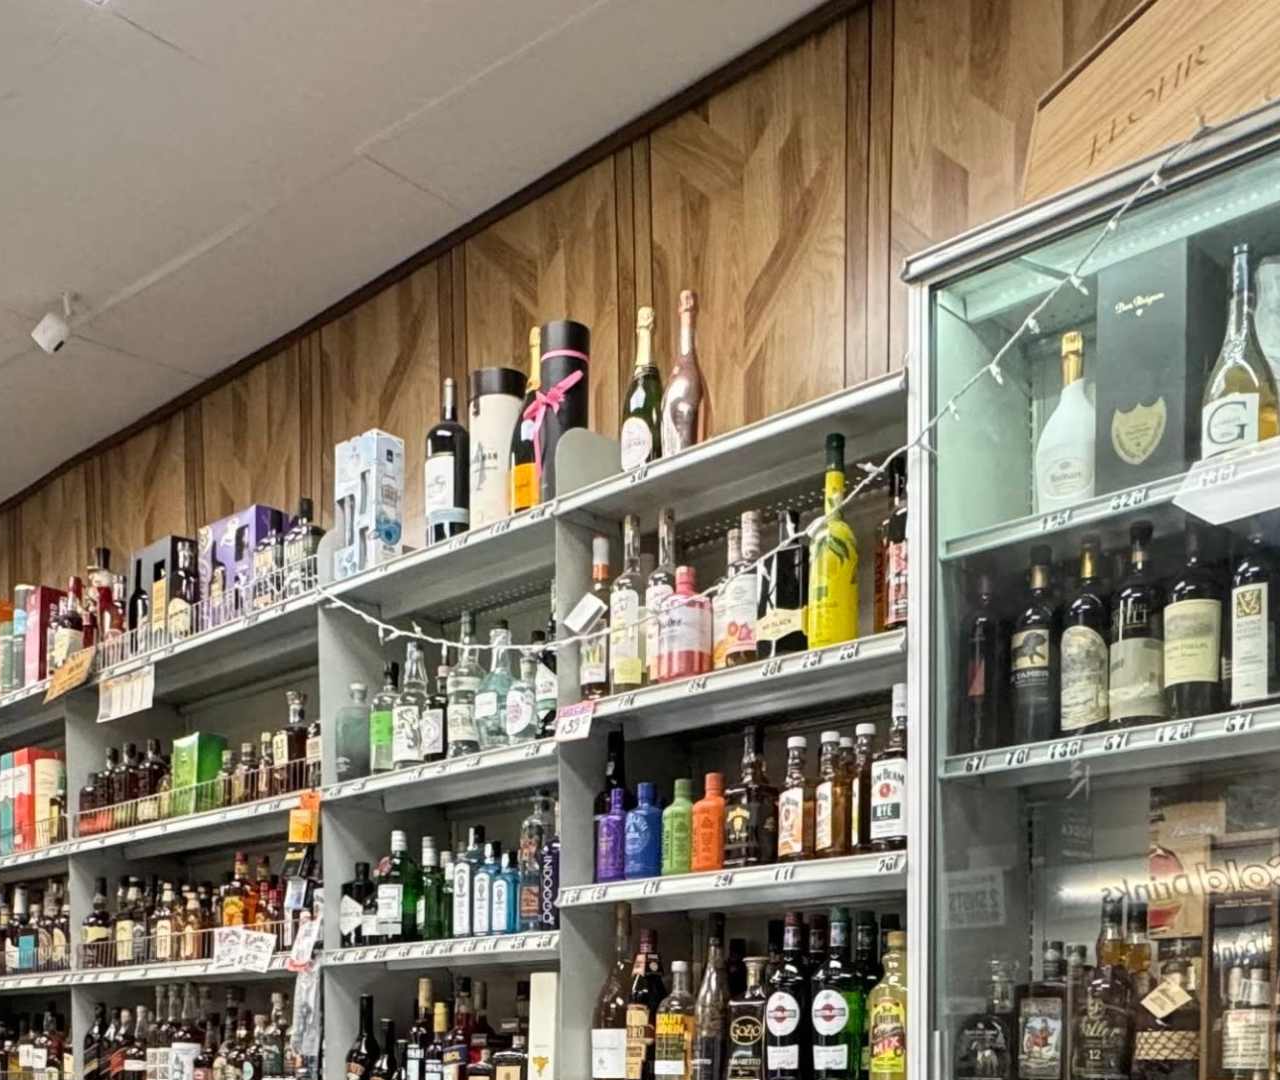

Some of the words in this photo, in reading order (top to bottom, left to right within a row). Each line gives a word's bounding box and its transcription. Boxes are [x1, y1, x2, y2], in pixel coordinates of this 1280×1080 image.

[1208, 401, 1247, 445] G
[876, 806, 893, 816] RYE
[1088, 1048, 1102, 1060] 12
